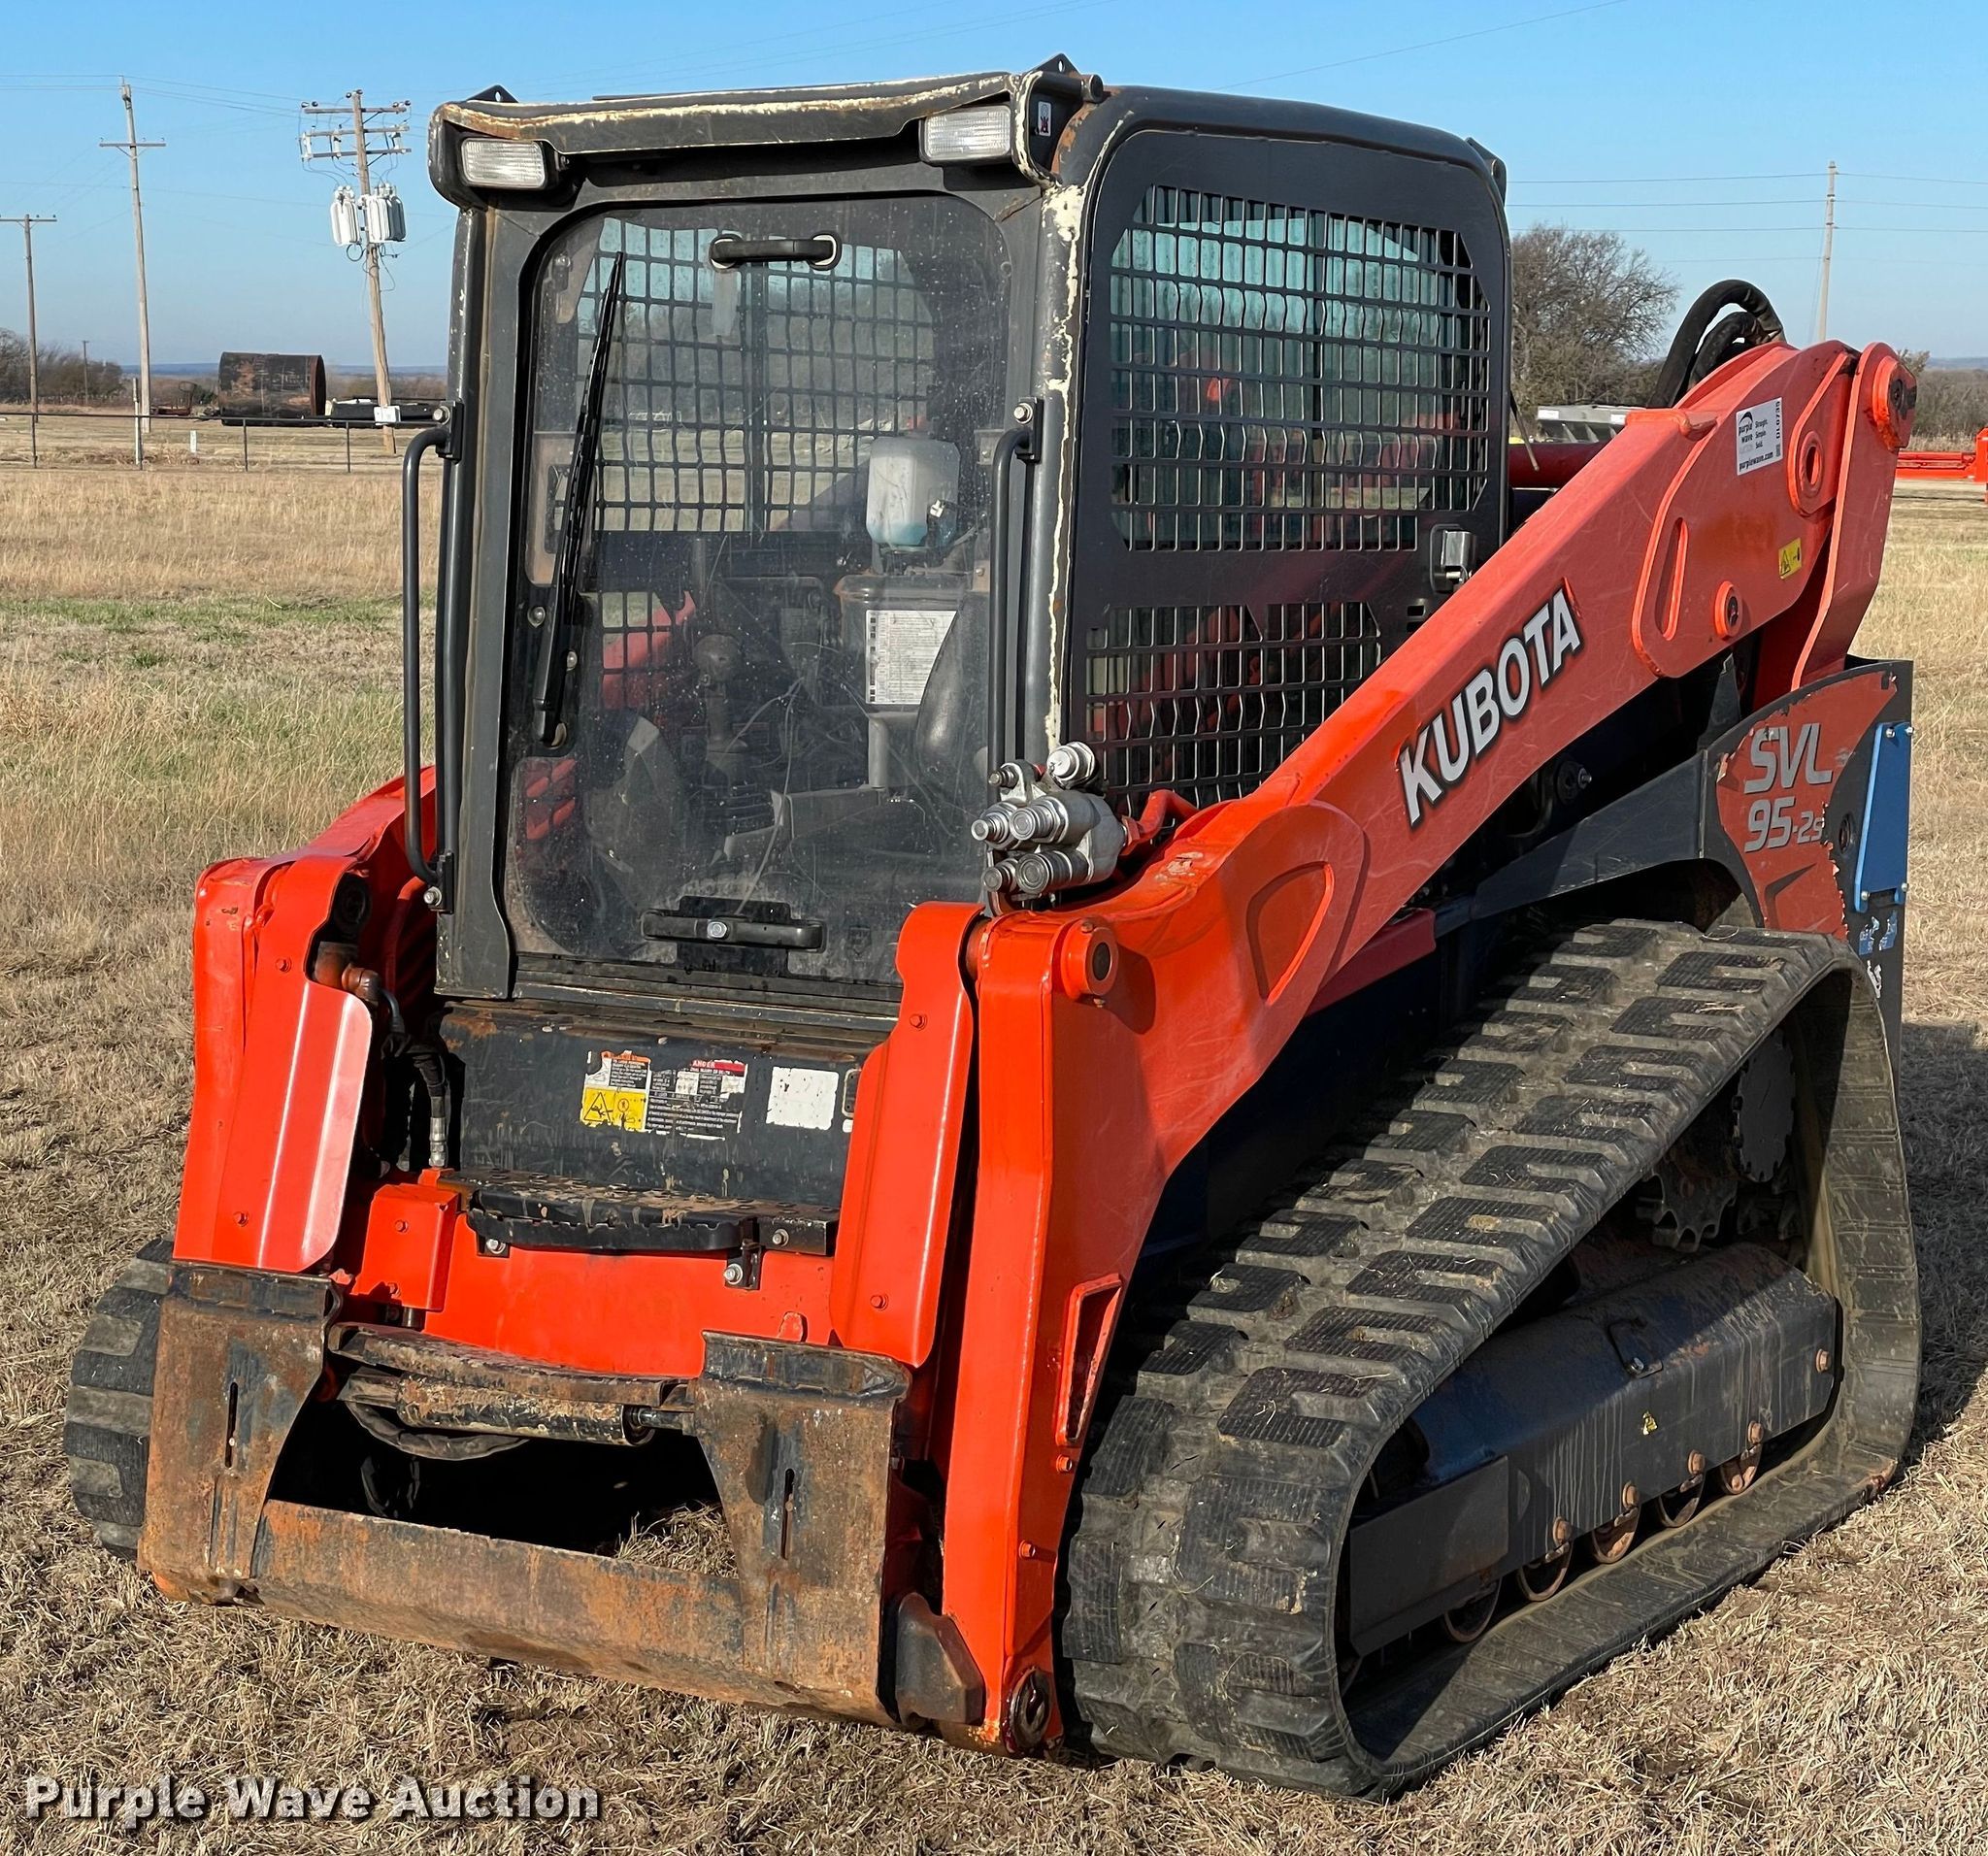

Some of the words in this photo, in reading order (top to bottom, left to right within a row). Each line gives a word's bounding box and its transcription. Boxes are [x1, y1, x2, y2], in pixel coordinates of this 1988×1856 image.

[1739, 422, 1753, 436] purple
[1741, 434, 1753, 443] wave
[1739, 451, 1773, 472] purplewave.com
[1398, 586, 1582, 827] KUBOTA
[1743, 722, 1833, 794] SVL
